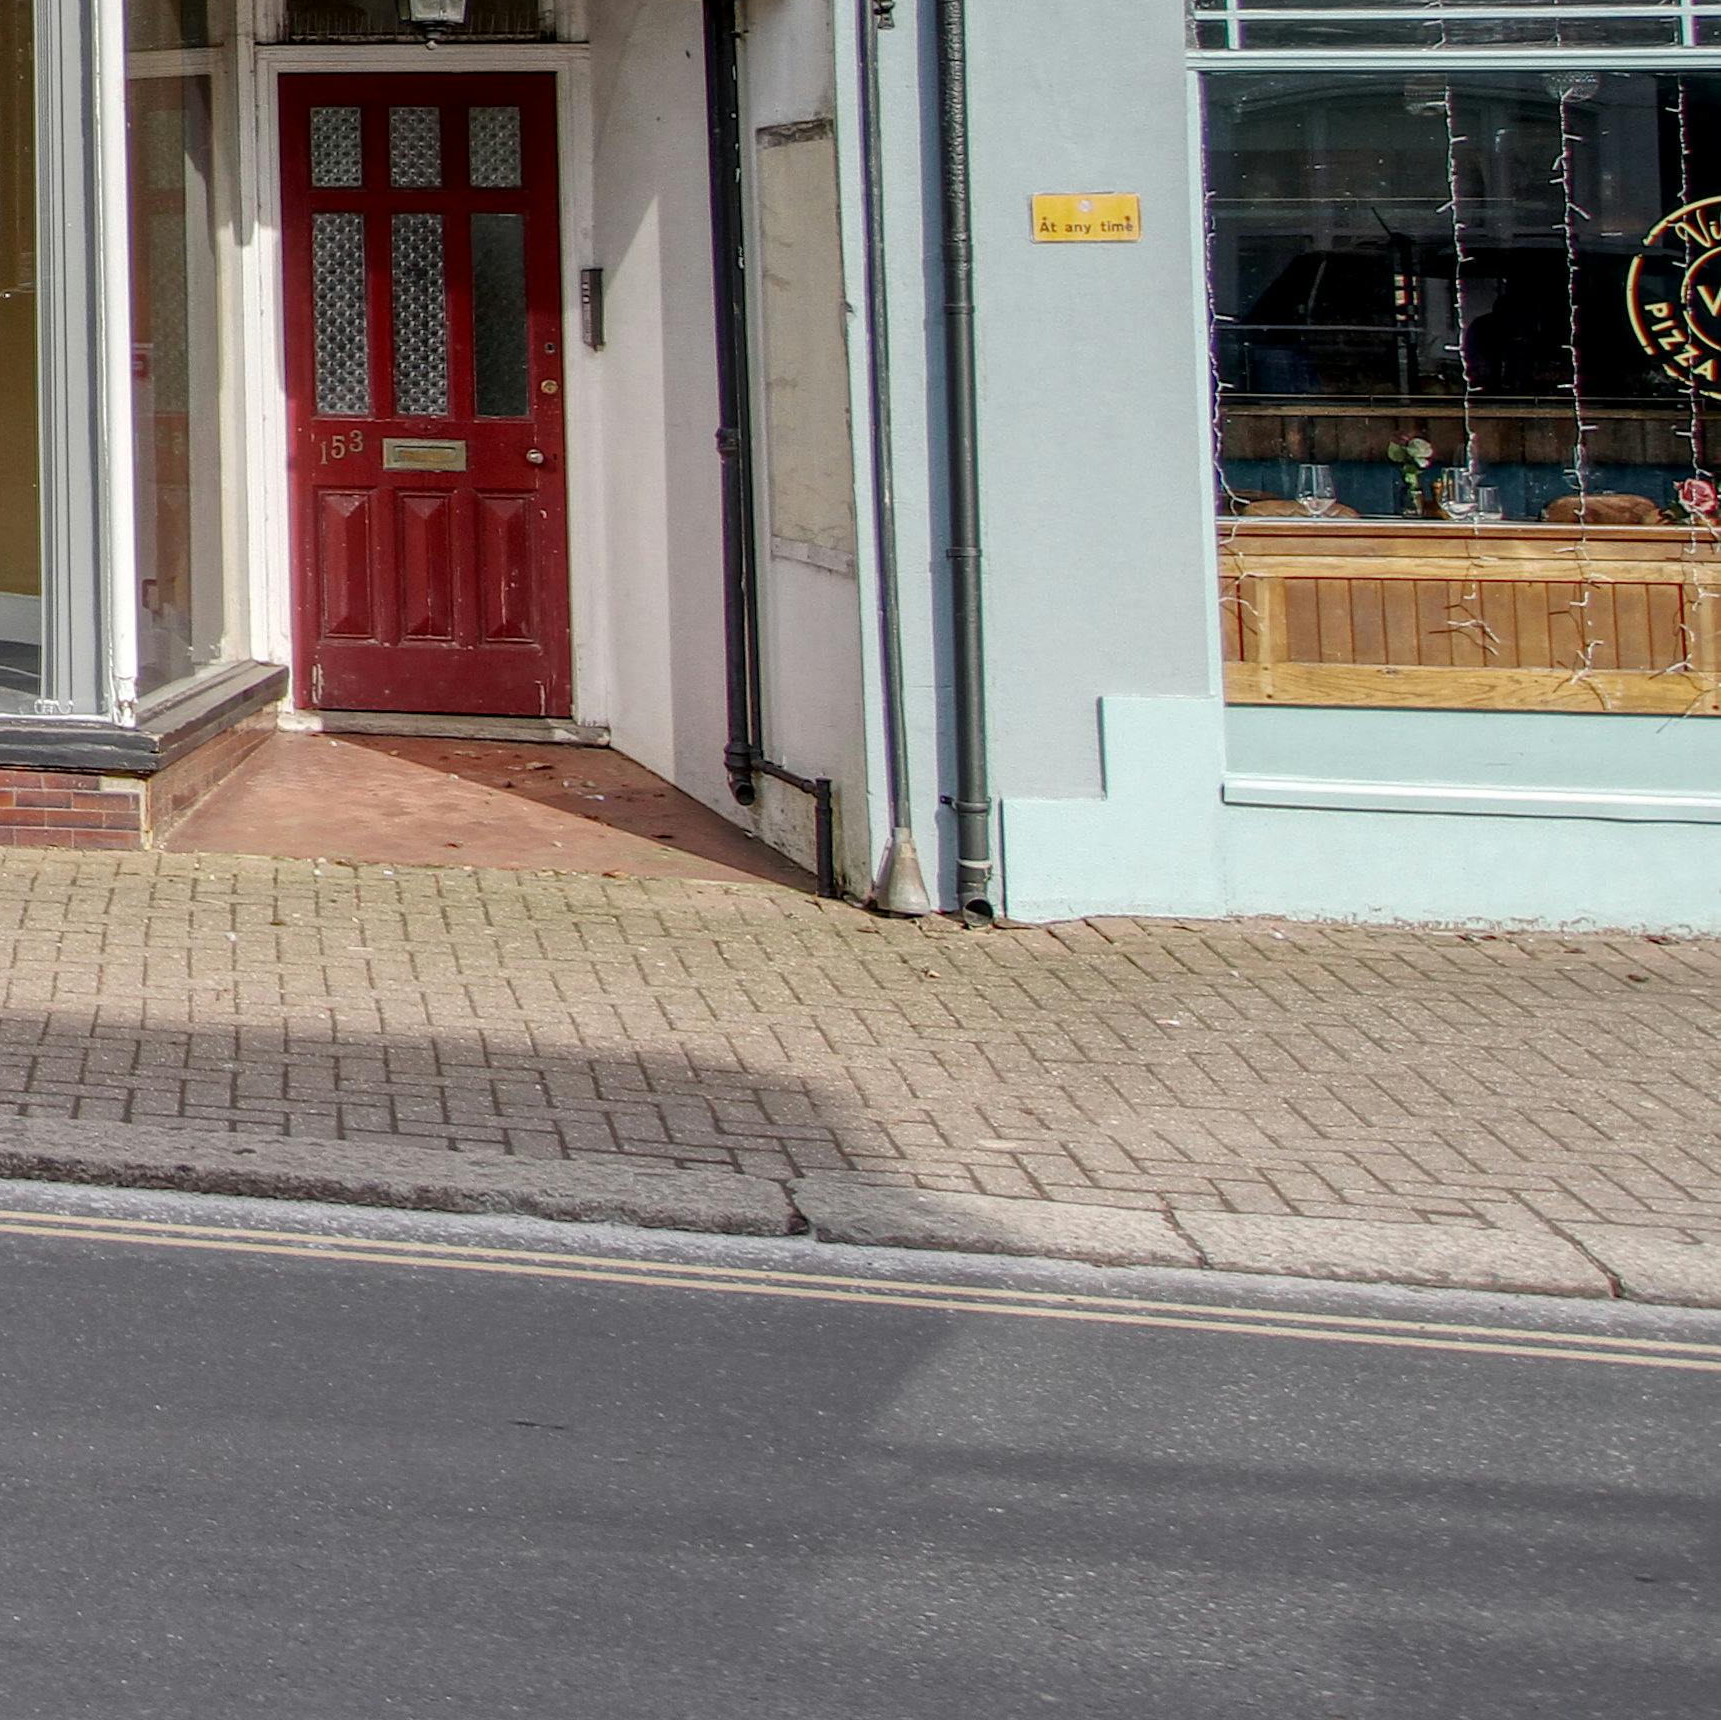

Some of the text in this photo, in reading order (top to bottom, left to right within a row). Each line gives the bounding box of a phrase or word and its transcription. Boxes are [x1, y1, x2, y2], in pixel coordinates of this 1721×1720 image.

[1039, 220, 1134, 234] At any time
[1644, 302, 1719, 381] PIZZA
[320, 430, 364, 464] 153
